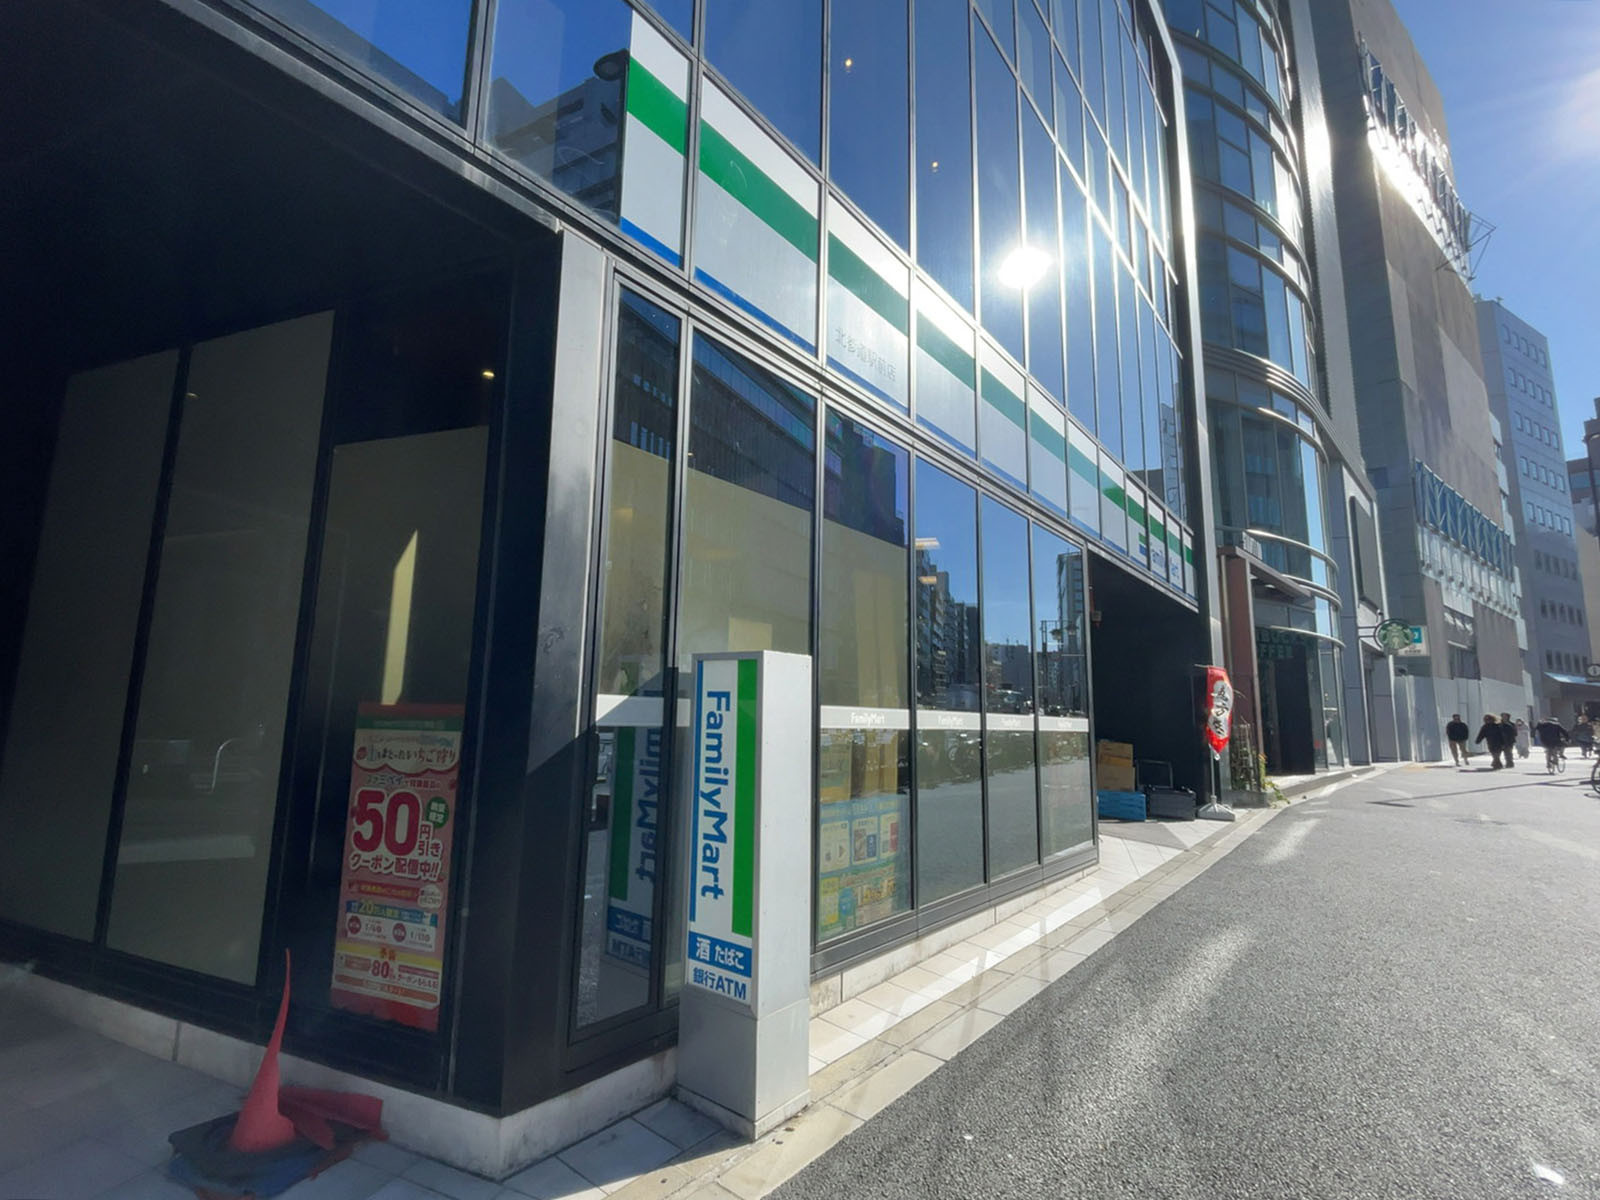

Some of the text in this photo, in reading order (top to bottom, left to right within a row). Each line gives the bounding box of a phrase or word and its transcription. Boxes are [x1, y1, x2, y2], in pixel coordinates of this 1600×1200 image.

[700, 690, 731, 900] FamilyMart
[352, 789, 421, 857] 50
[696, 936, 745, 970] 酒 たばこ
[692, 966, 747, 1001] 銀行ATM
